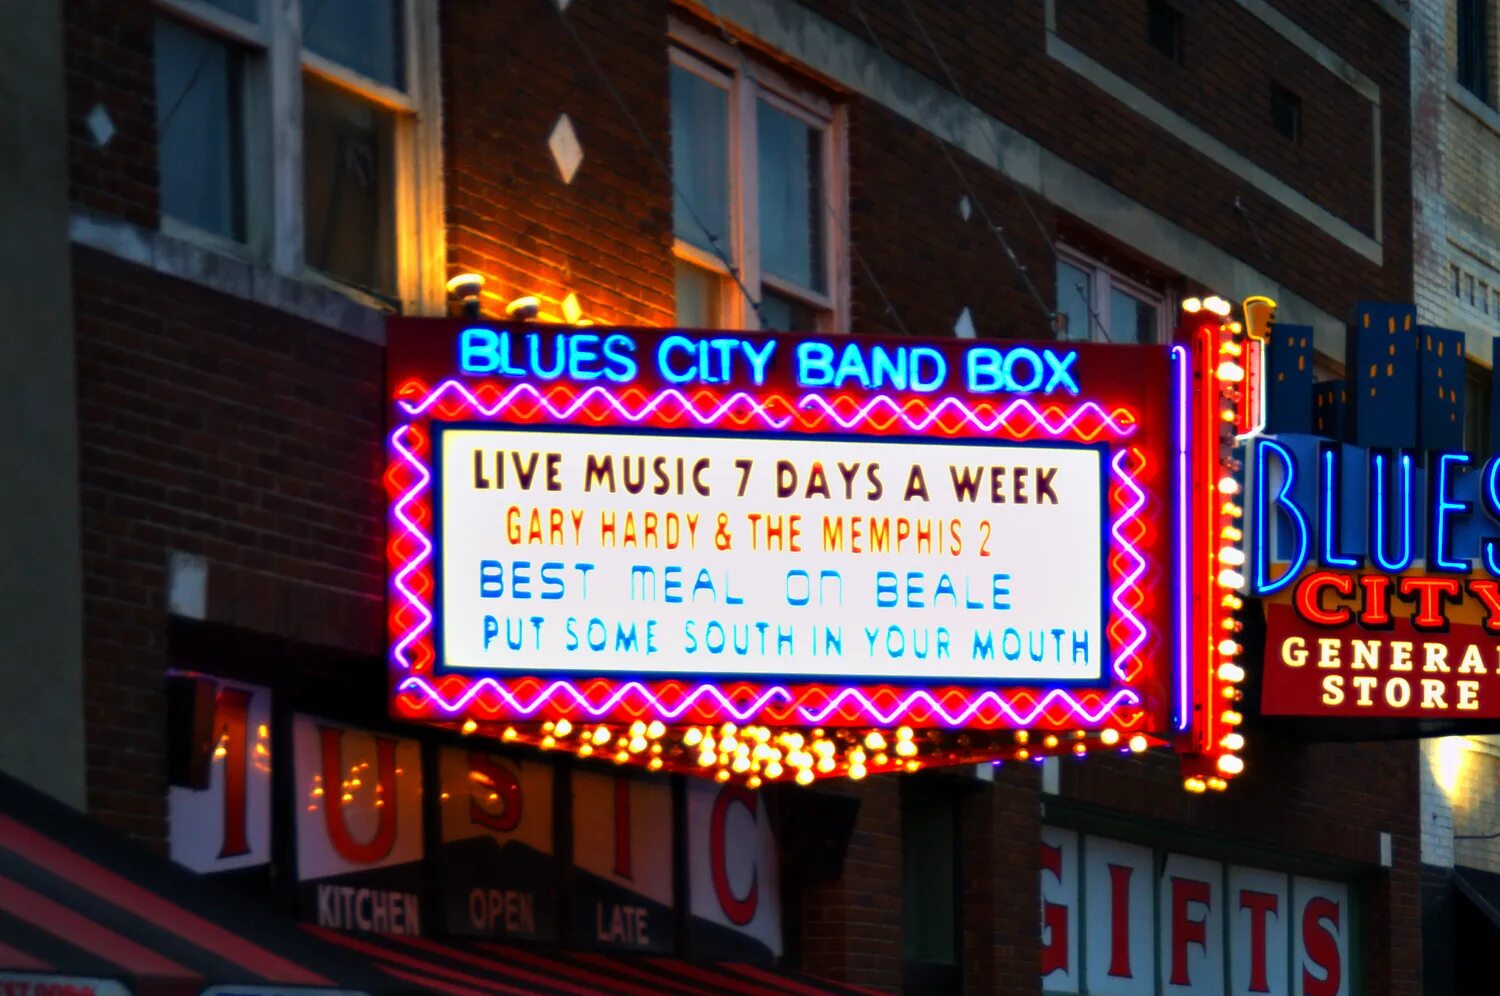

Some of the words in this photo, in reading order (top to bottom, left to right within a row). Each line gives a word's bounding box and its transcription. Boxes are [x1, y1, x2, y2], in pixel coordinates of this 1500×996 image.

[460, 328, 637, 381] BLUES
[658, 336, 777, 387] CITY
[798, 342, 947, 393] BAND
[966, 347, 1080, 396] BOX
[473, 449, 563, 493] LIVE
[584, 455, 713, 498] MUSIC
[735, 459, 755, 497] 7
[776, 461, 884, 501] DAYS
[904, 465, 930, 502] A
[949, 465, 1060, 505] WEEK
[505, 506, 585, 548] GARY
[601, 510, 699, 552] HARDY
[714, 515, 733, 552] &
[747, 514, 804, 554] THE
[822, 517, 963, 558] MEMPHIS
[978, 520, 993, 558] 2
[479, 560, 596, 601] BEST
[876, 571, 1013, 611] BEALE
[482, 615, 546, 653] PUT
[564, 617, 658, 656] SOME
[684, 619, 794, 657] SOUTH
[811, 625, 843, 659] IN
[864, 625, 951, 663] YOUR
[971, 629, 1090, 667] MOUTH
[1322, 674, 1480, 711] STORE
[317, 885, 422, 935] KITCHEN
[468, 887, 536, 933] OPEN
[596, 902, 650, 946] LATE
